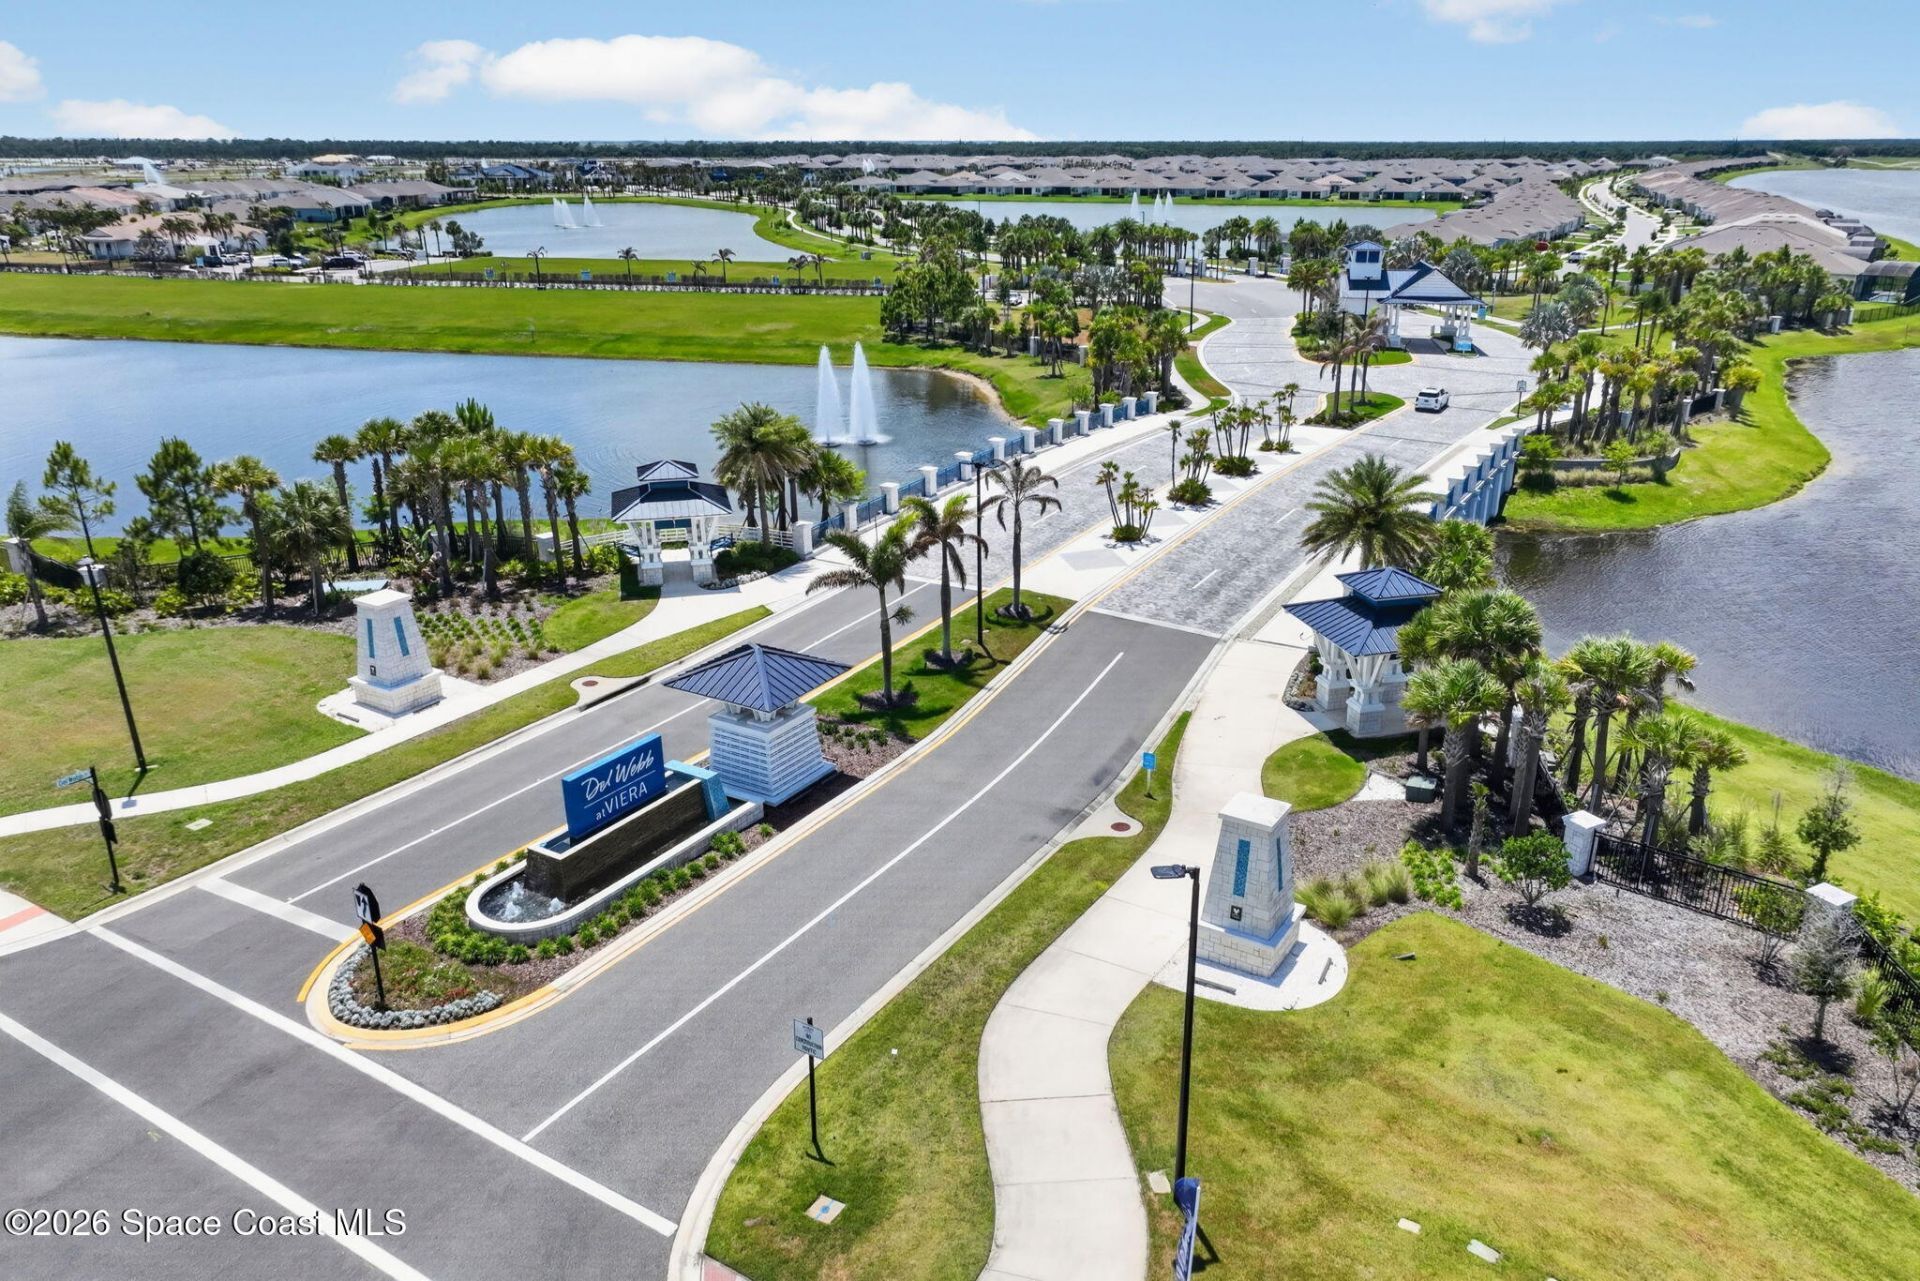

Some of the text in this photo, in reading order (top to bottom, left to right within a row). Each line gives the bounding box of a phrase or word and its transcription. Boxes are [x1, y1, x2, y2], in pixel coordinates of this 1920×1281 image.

[581, 749, 655, 801] Del Webb
[595, 782, 648, 821] at VIERA
